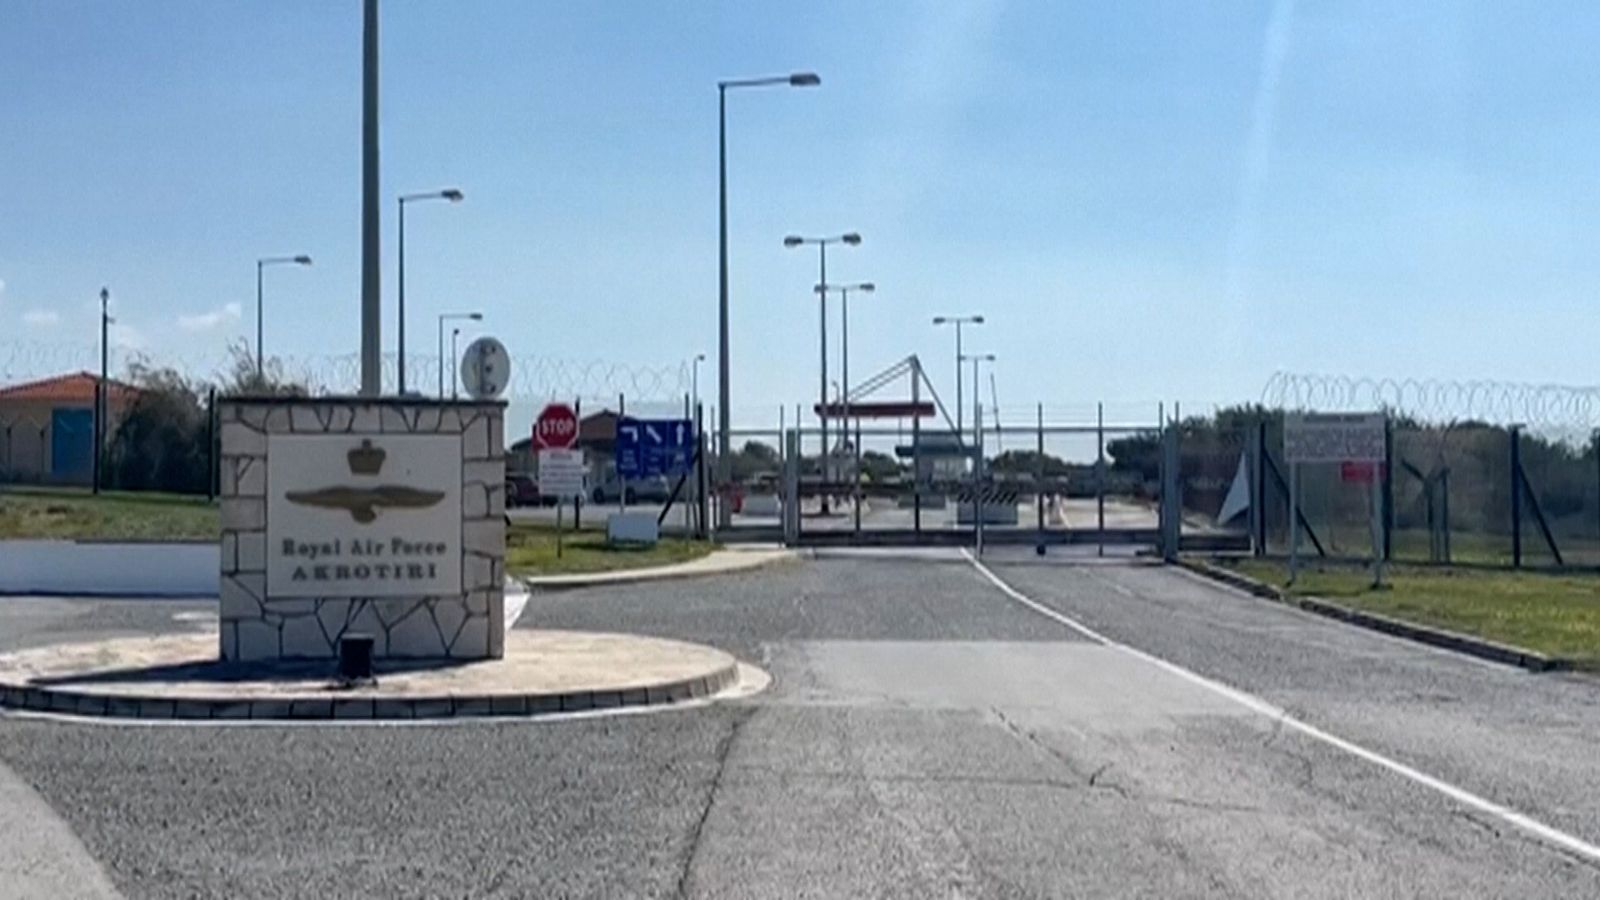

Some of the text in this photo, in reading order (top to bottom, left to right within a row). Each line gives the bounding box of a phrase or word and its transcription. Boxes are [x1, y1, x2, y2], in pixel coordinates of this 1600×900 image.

[542, 419, 575, 436] STOP
[282, 537, 447, 560] Royal Air Force
[291, 563, 437, 581] AKROTIRI
